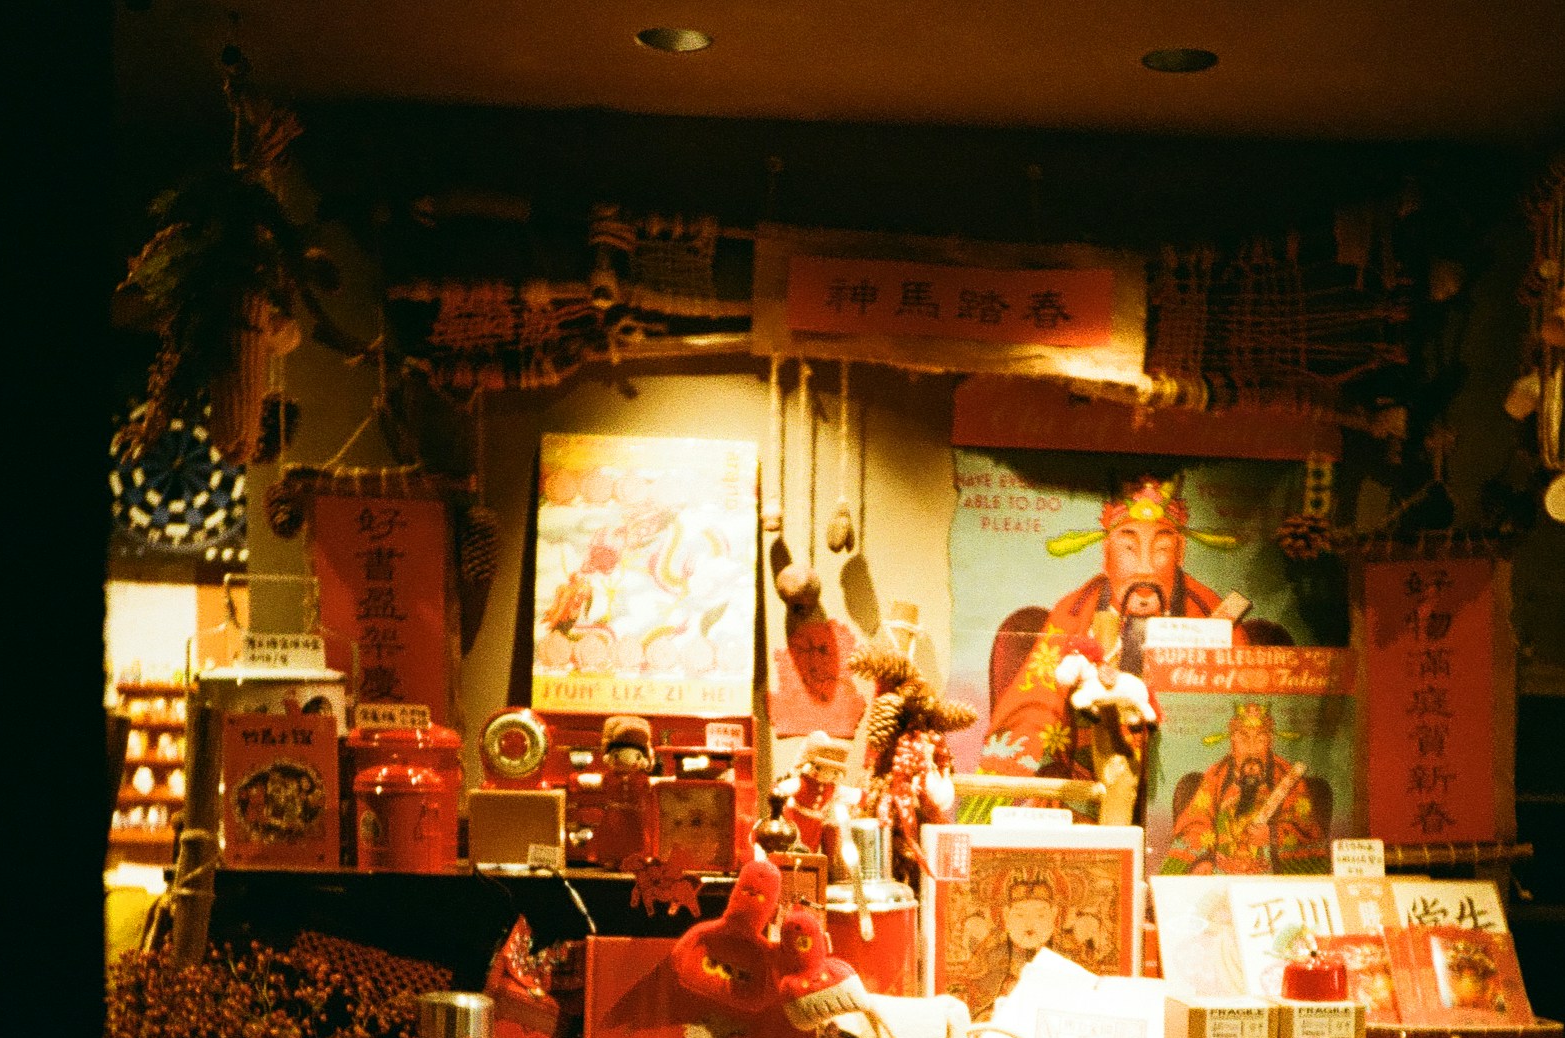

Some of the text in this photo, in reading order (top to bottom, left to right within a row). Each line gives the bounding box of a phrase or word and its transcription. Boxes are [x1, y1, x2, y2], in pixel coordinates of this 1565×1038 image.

[826, 279, 1073, 330] 神馬踏春
[963, 494, 1062, 512] ABLE TO DO
[980, 517, 1043, 533] PLEASE
[1215, 649, 1300, 666] BLESSING
[1213, 667, 1237, 690] of
[1209, 1007, 1264, 1016] FRAGILE
[1298, 1006, 1349, 1015] FRAGILE
